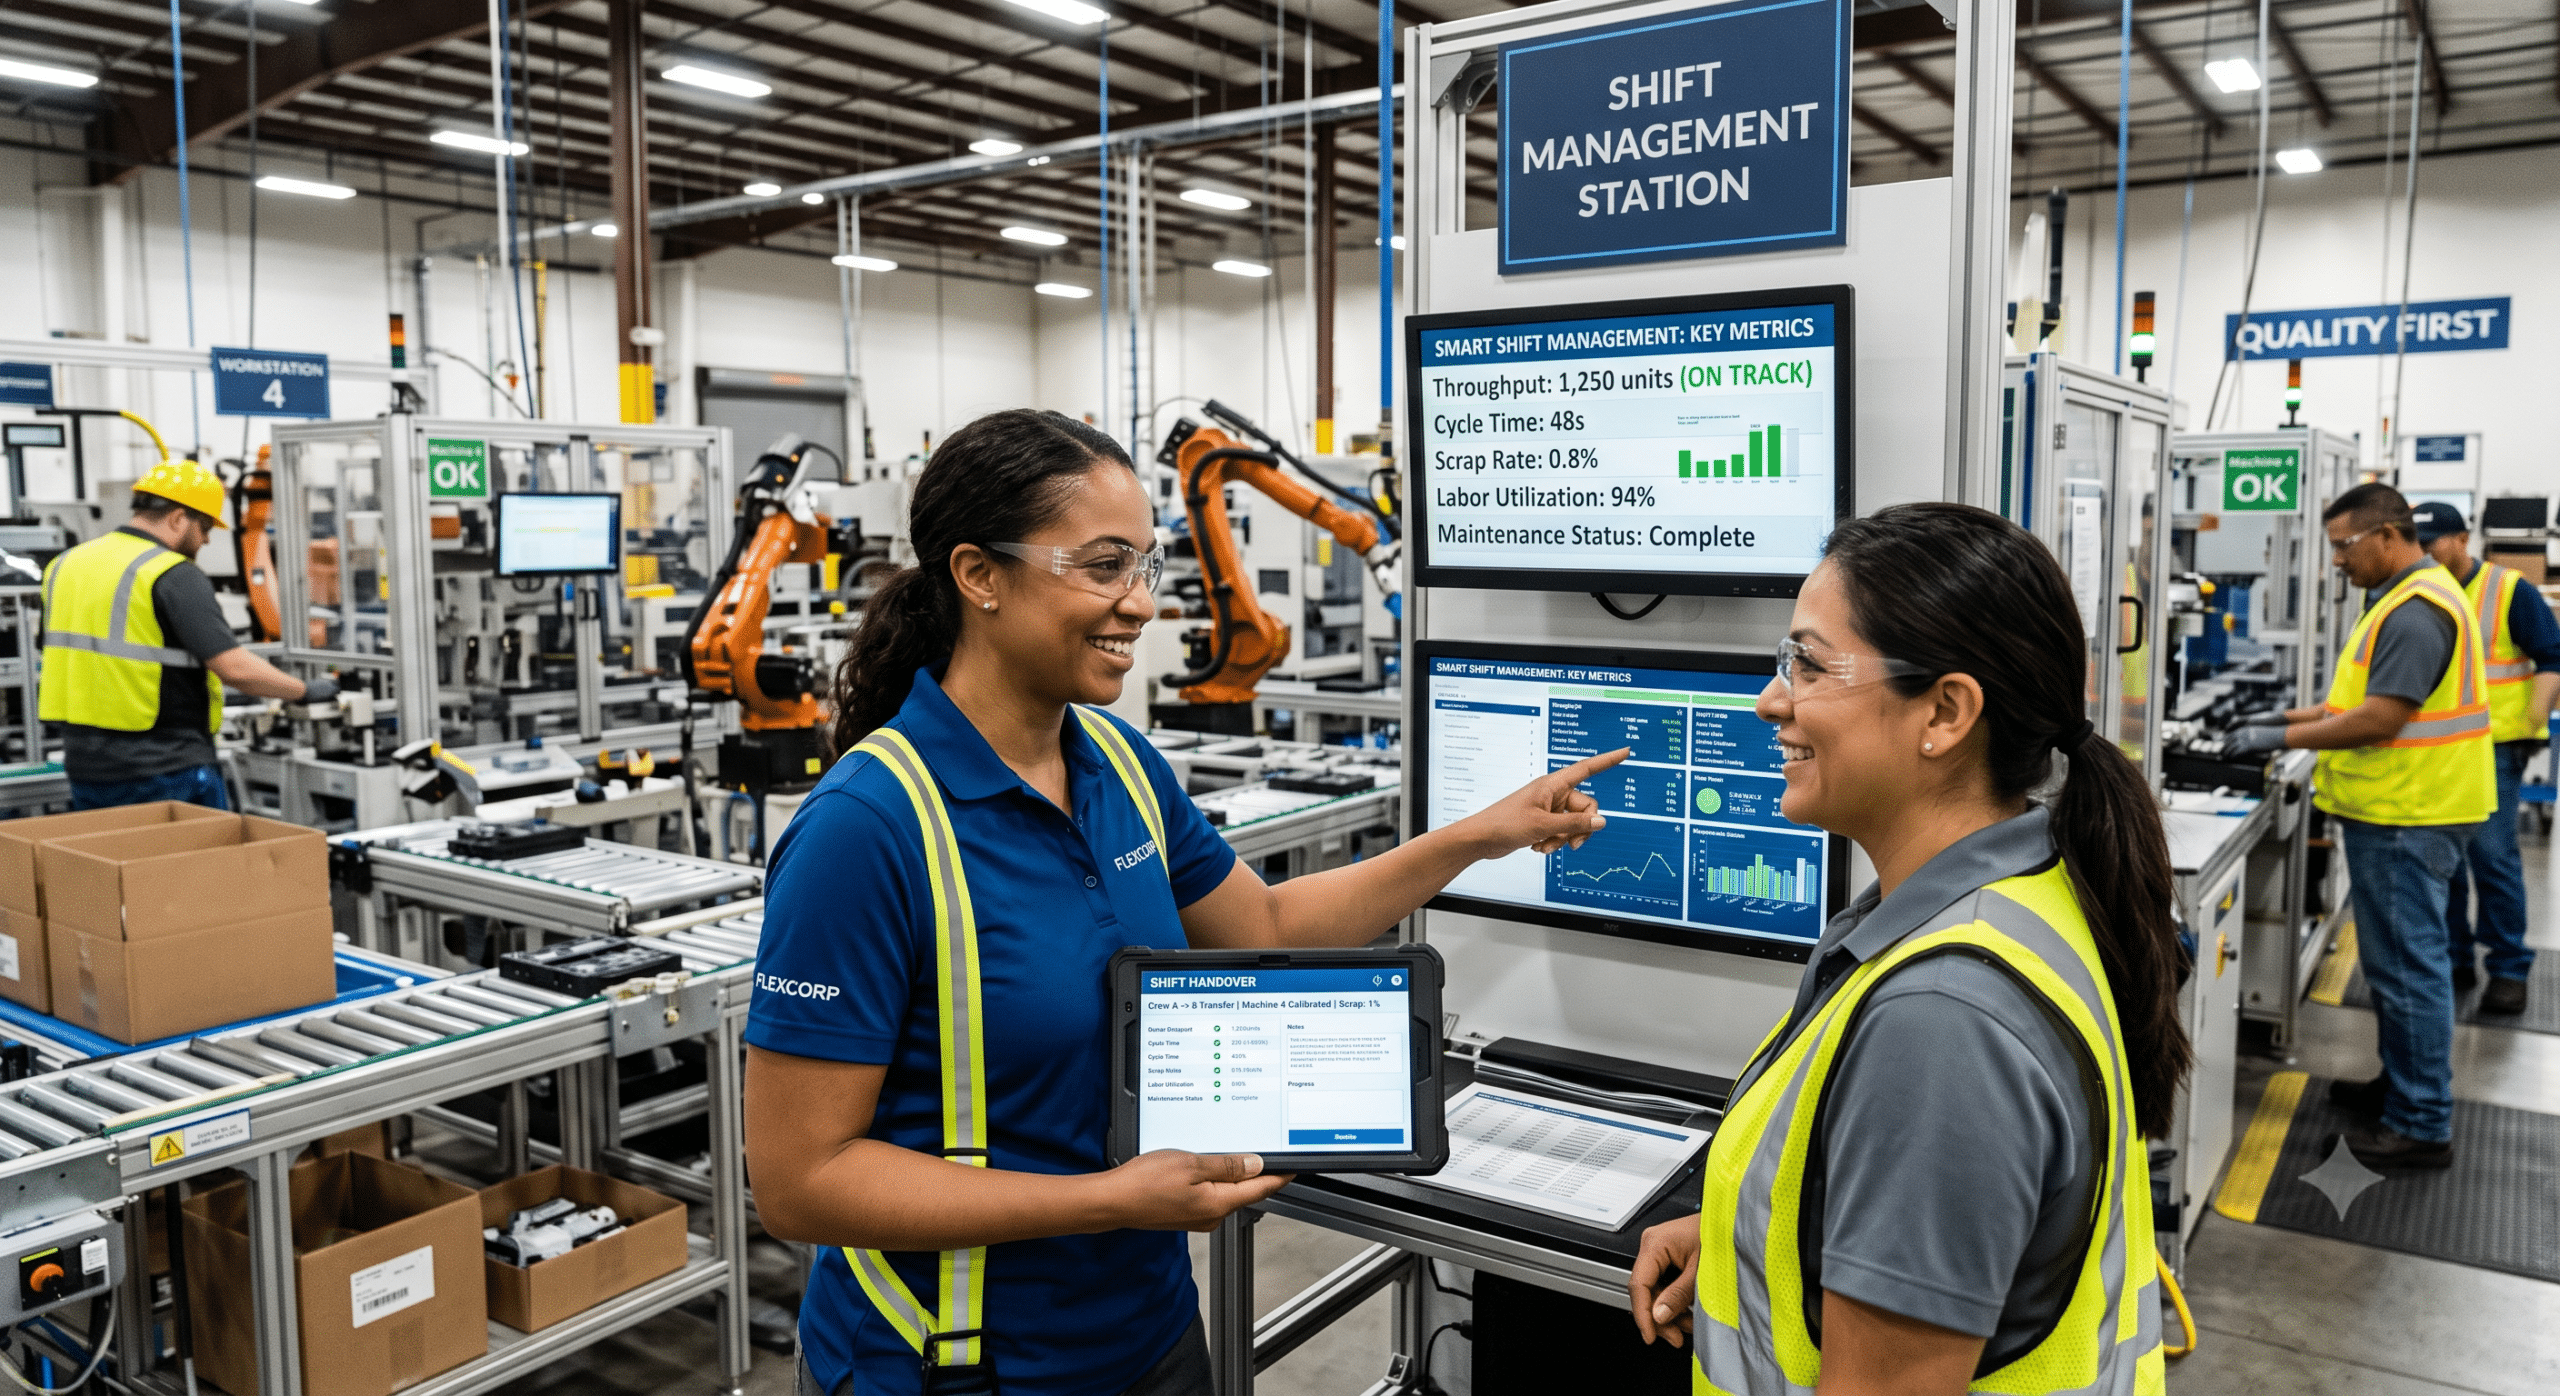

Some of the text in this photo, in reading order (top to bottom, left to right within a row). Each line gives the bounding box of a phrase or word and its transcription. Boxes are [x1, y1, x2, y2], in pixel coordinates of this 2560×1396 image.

[1608, 61, 1721, 111] SHIFT
[1523, 102, 1819, 174] MANAGEMENT
[1578, 166, 1749, 218] STATION
[1435, 317, 1815, 358] SMART SHIFT MANAGEMENT: KEY METRICS
[2236, 308, 2499, 354] QUALITY FIRST
[218, 357, 324, 377] WORKSTATION
[1433, 359, 1813, 400] Throughput: 1,250 units (ON TRACK)
[262, 378, 286, 409] 4
[1434, 410, 1585, 439] Cycle Time: 48s
[434, 460, 480, 489] OK
[1435, 447, 1598, 475] Scrap Rate: 0.8%
[1437, 486, 1656, 508] Labor Utilization: 94%
[2232, 473, 2288, 503] OK
[1438, 524, 1755, 552] Maintenance Status: Complete
[1436, 662, 1632, 684] SMART SHIFT MANAGEMENT: KEY METRICS
[1114, 840, 1156, 871] FLEXCORP
[756, 972, 840, 1001] FLEXCORP
[1150, 976, 1256, 988] SHIFT HANDOVER
[1148, 1001, 1169, 1010] Crew
[1172, 1001, 1178, 1009] A
[1199, 1000, 1235, 1009] Transfer
[1242, 1000, 1278, 1009] Machine
[1280, 1000, 1286, 1008] 4
[1288, 1000, 1331, 1008] Calibrated
[1339, 1000, 1365, 1009] Scrap:
[1369, 1000, 1380, 1008] 1%
